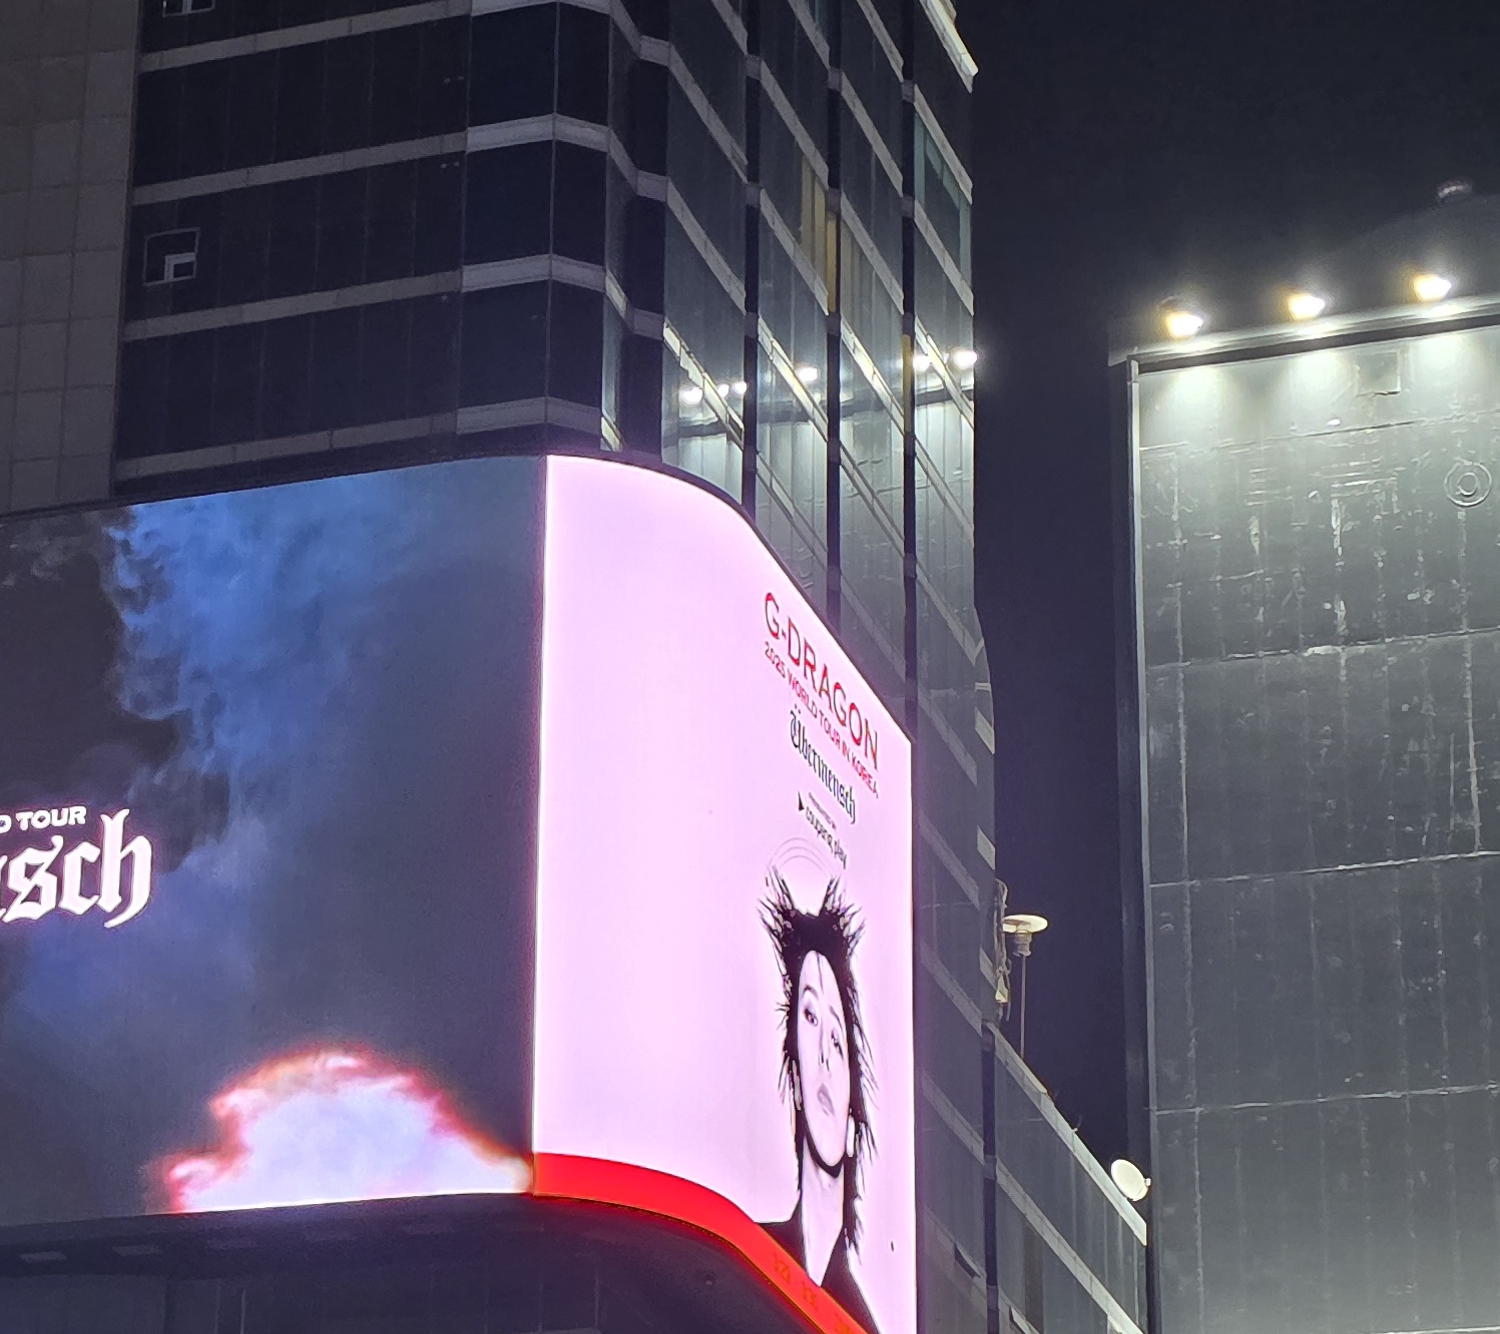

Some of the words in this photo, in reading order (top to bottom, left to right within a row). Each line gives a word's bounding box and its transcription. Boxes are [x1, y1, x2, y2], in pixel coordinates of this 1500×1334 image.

[764, 641, 786, 679] 2025
[787, 669, 818, 719] WORLD
[819, 709, 841, 749] TOUR
[841, 740, 850, 763] IN
[851, 752, 879, 799] KOREA
[765, 592, 879, 771] G-DRAGON
[16, 805, 87, 831] TOUR
[790, 704, 856, 825] Übermensch
